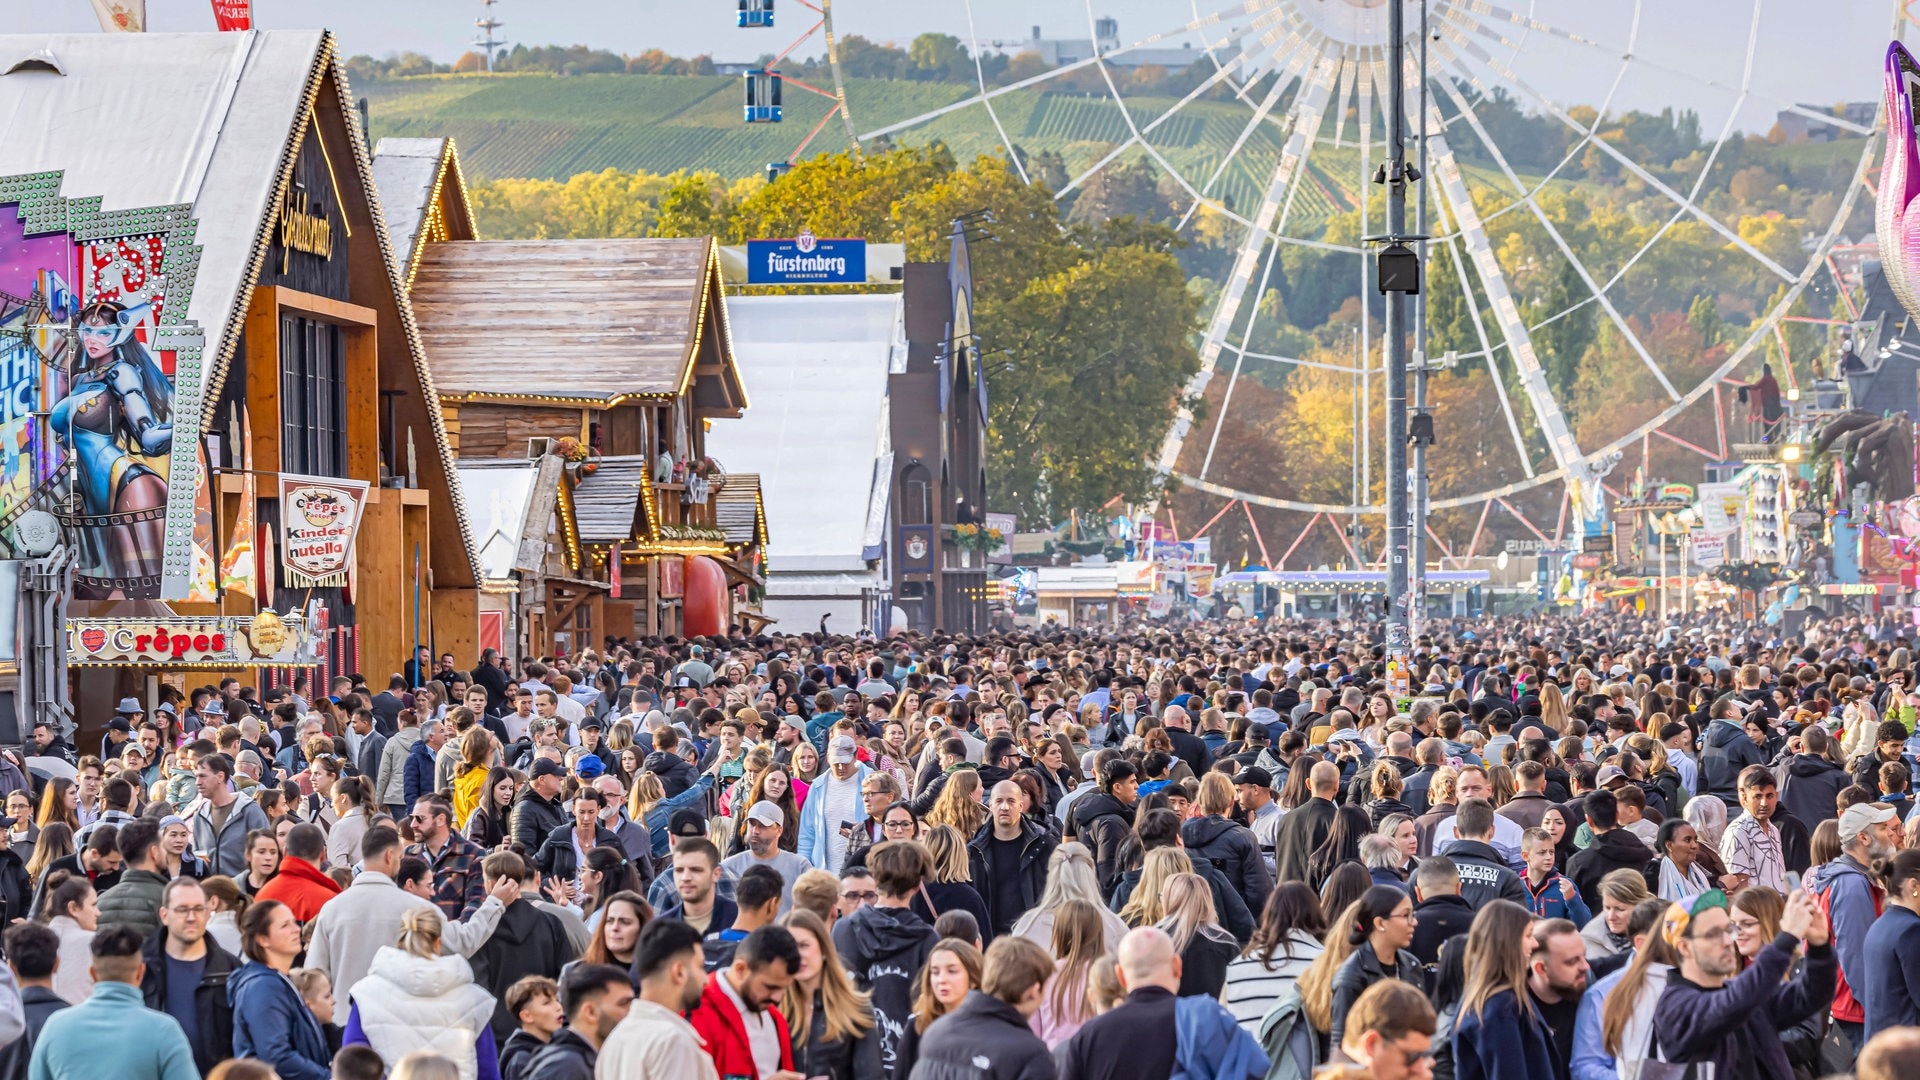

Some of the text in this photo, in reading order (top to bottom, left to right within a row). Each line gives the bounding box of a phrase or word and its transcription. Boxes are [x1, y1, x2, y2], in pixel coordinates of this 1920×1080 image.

[296, 498, 346, 513] Crêpes
[290, 543, 342, 557] nutella
[111, 627, 225, 657] Crêpes
